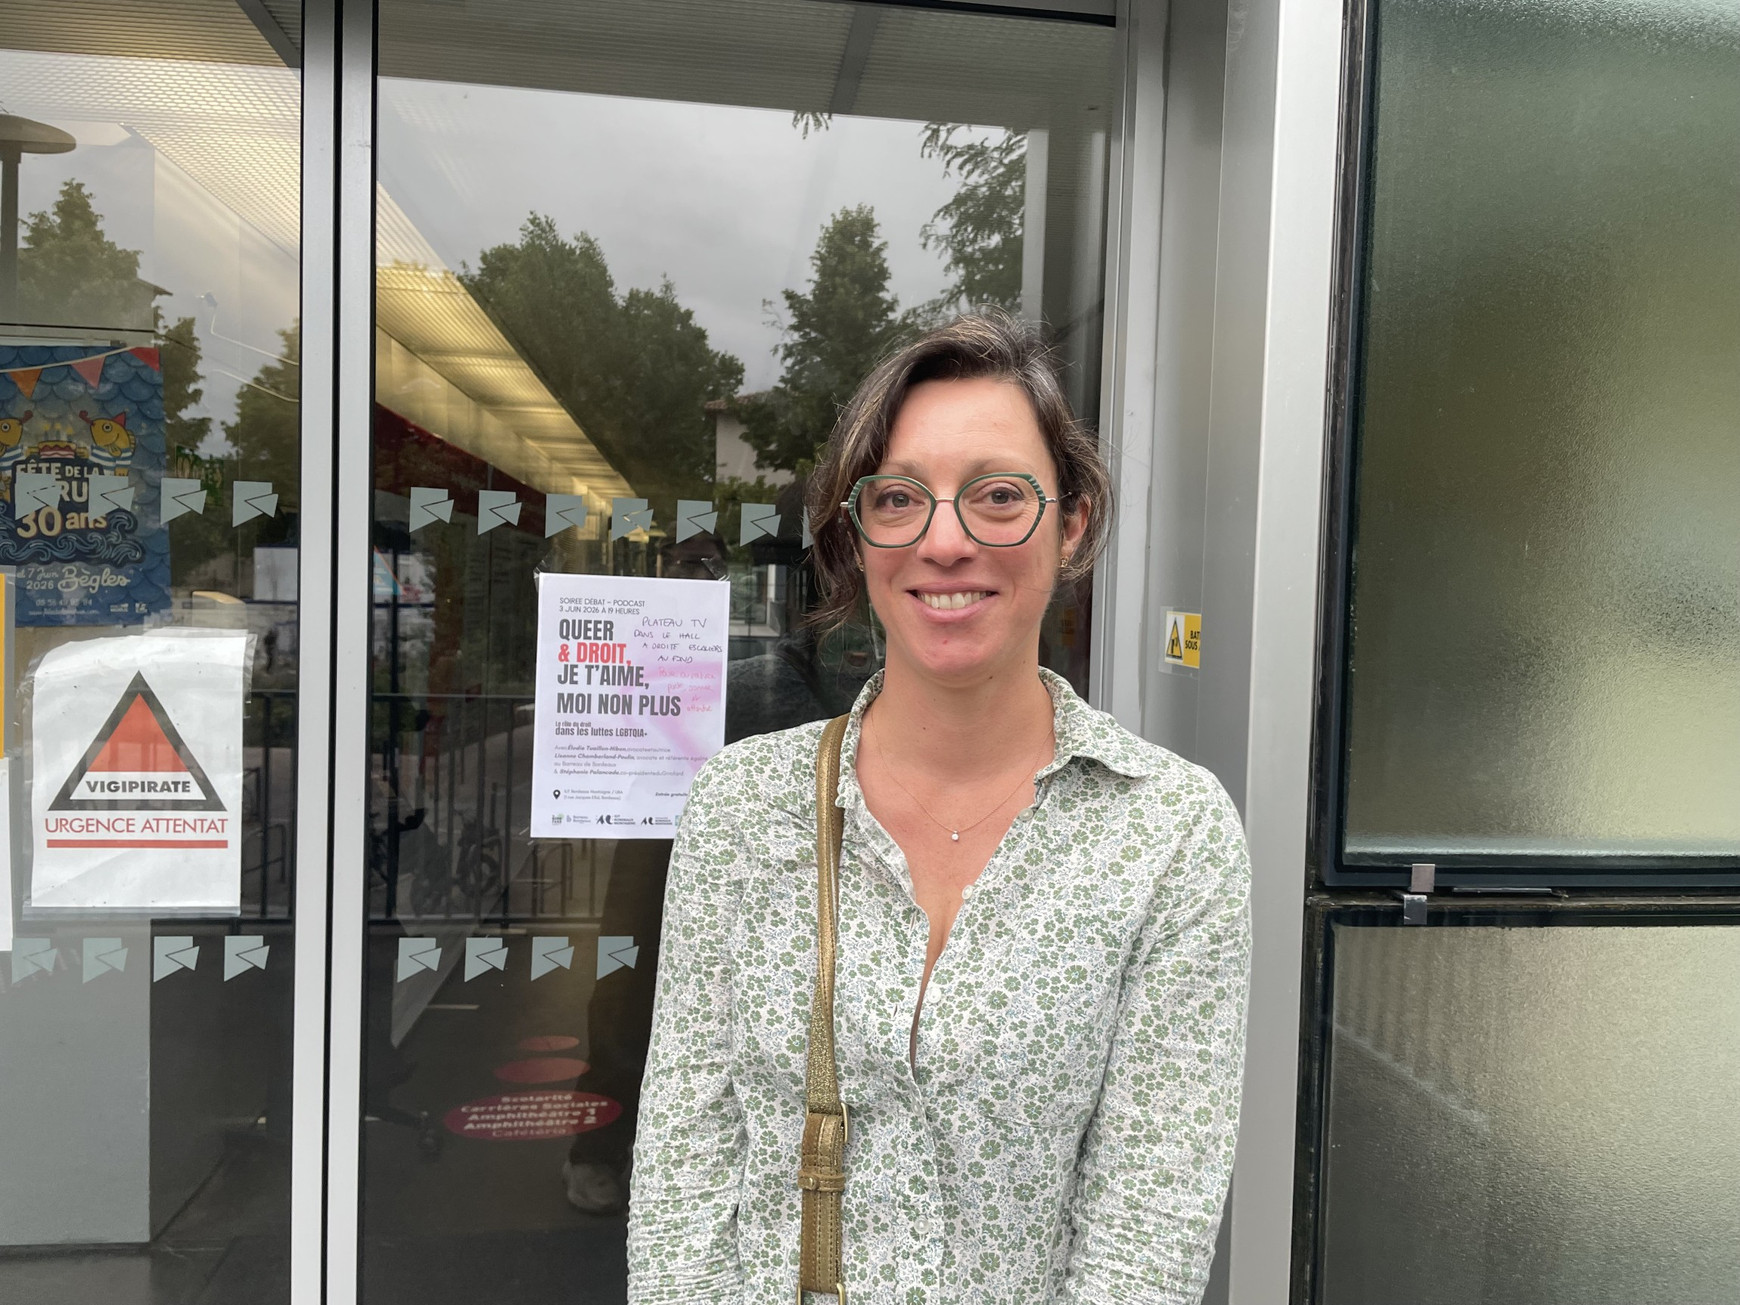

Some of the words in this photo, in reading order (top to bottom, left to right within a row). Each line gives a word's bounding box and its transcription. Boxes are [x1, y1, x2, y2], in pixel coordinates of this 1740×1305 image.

[65, 466, 81, 477] DE
[28, 568, 35, 578] 7
[26, 581, 54, 590] 2026
[58, 566, 131, 594] Bègles
[583, 606, 599, 614] 2026
[642, 616, 683, 628] PLATEAU
[691, 618, 708, 628] TV
[559, 618, 614, 641] QUEER
[634, 630, 654, 638] DANS
[679, 632, 700, 640] HALL
[1185, 640, 1198, 651] SOUS
[558, 643, 570, 662] &
[577, 642, 632, 666] DROIT,
[557, 664, 578, 685] JE
[557, 693, 592, 714] MOI
[598, 693, 632, 715] NON
[638, 695, 681, 716] PLUS
[555, 727, 575, 736] dans
[577, 727, 589, 736] les
[591, 727, 613, 737] luttes
[615, 728, 647, 738] LGBTQIA+
[85, 781, 191, 793] VIGIPIRATE
[45, 817, 135, 833] URGENCE
[141, 818, 229, 834] ATTENTAT
[501, 1094, 573, 1103] Scolarité
[542, 1100, 609, 1110] Sociales
[468, 1110, 582, 1121] Amphithéâtre
[464, 1118, 579, 1130] Amphithéâtre
[583, 1116, 597, 1124] 2
